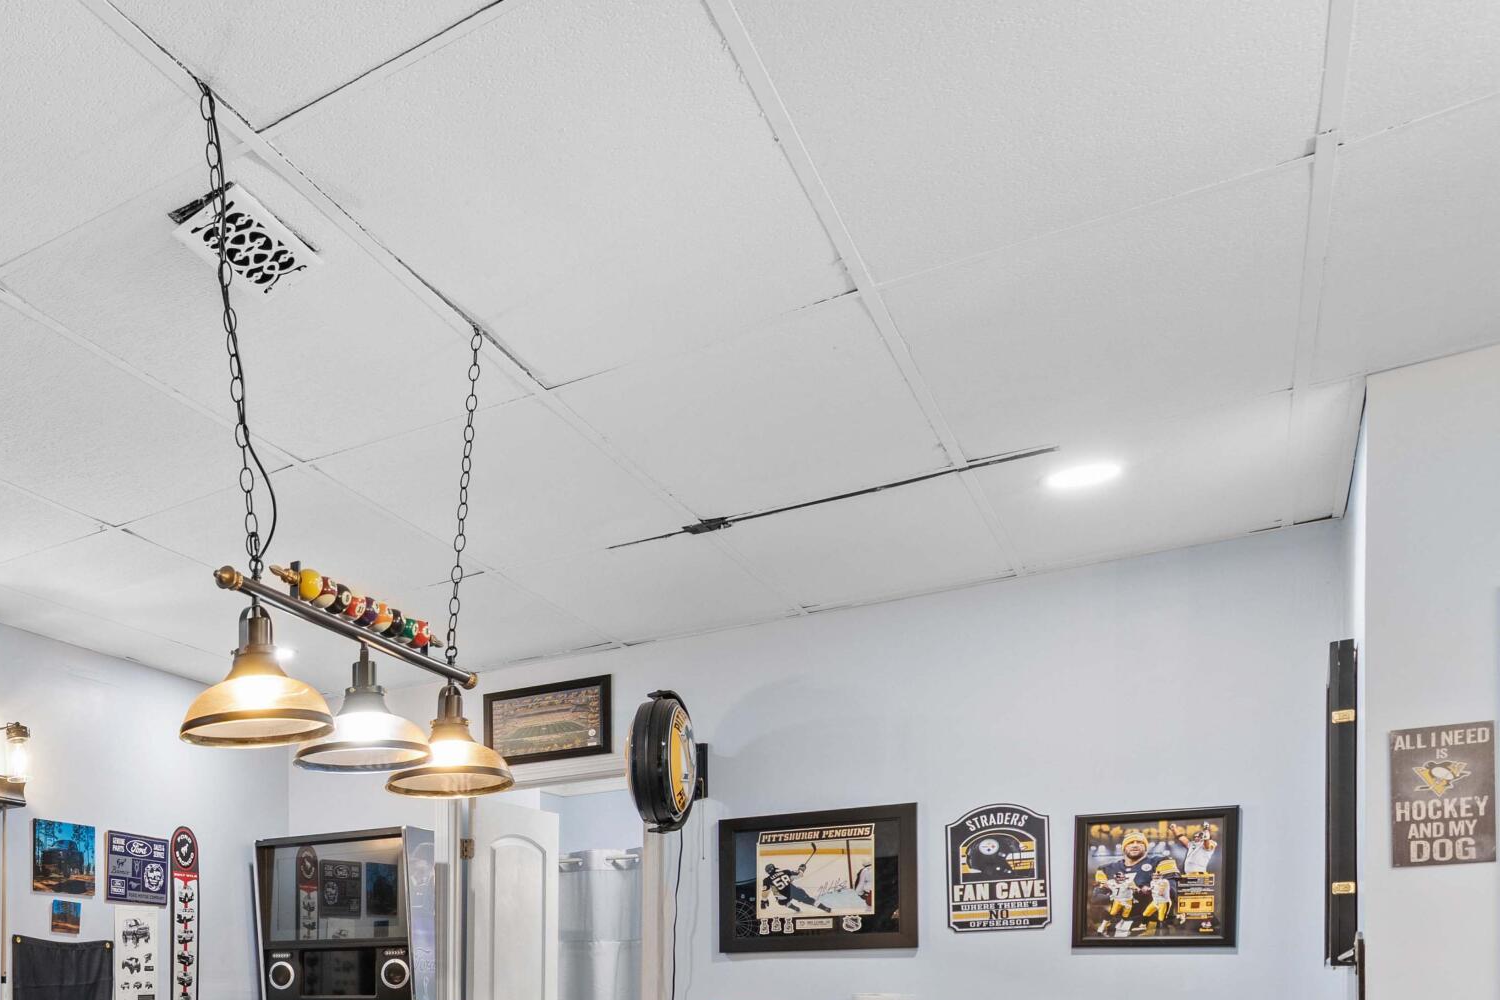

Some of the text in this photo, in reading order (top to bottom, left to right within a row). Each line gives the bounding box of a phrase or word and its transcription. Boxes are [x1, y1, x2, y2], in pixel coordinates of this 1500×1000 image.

[1394, 727, 1490, 751] ALL I NEED
[1435, 748, 1449, 759] IS
[1395, 795, 1489, 822] HOCKEY
[965, 812, 1029, 832] STRADERS
[1407, 819, 1478, 840] AND MY
[761, 827, 871, 843] PITTSBURGH PENGUINS
[130, 841, 148, 855] Ford
[1410, 837, 1477, 863] DOG
[953, 879, 1045, 902] FAN CAVE
[961, 901, 1038, 911] WHERE THERE'S
[989, 909, 1009, 920] NO
[969, 919, 1030, 928] OFFSEASON
